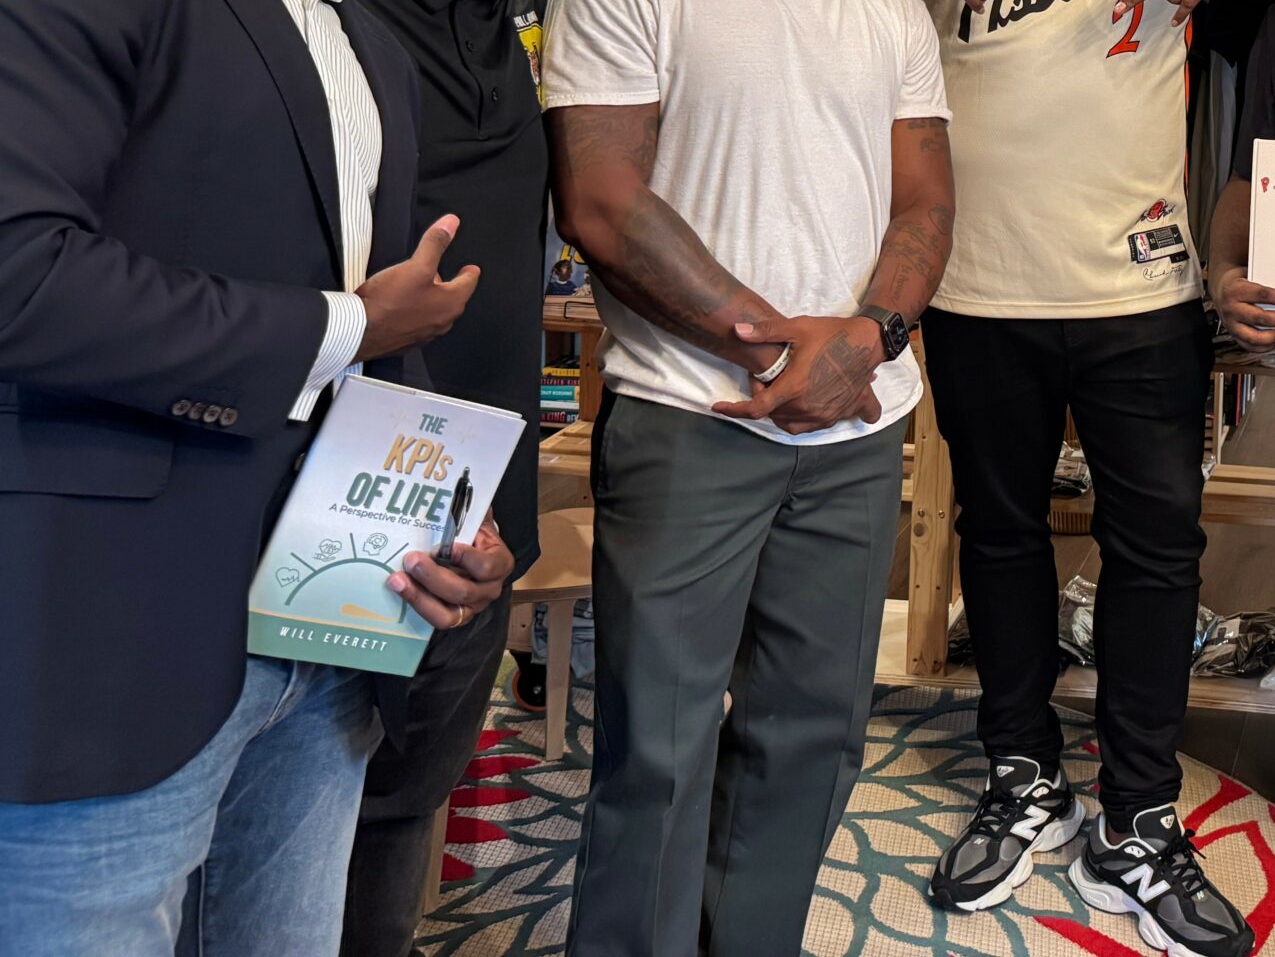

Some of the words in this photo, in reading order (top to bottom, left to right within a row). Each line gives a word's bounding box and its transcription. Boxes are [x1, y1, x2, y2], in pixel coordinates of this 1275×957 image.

[418, 413, 447, 435] THE
[383, 433, 454, 481] KPIs
[346, 472, 390, 507] OF
[386, 479, 452, 522] LIFE
[329, 503, 337, 512] A
[340, 504, 396, 524] Perspective
[398, 515, 412, 526] for
[279, 627, 314, 641] WILL
[324, 633, 387, 652] EVERETT
